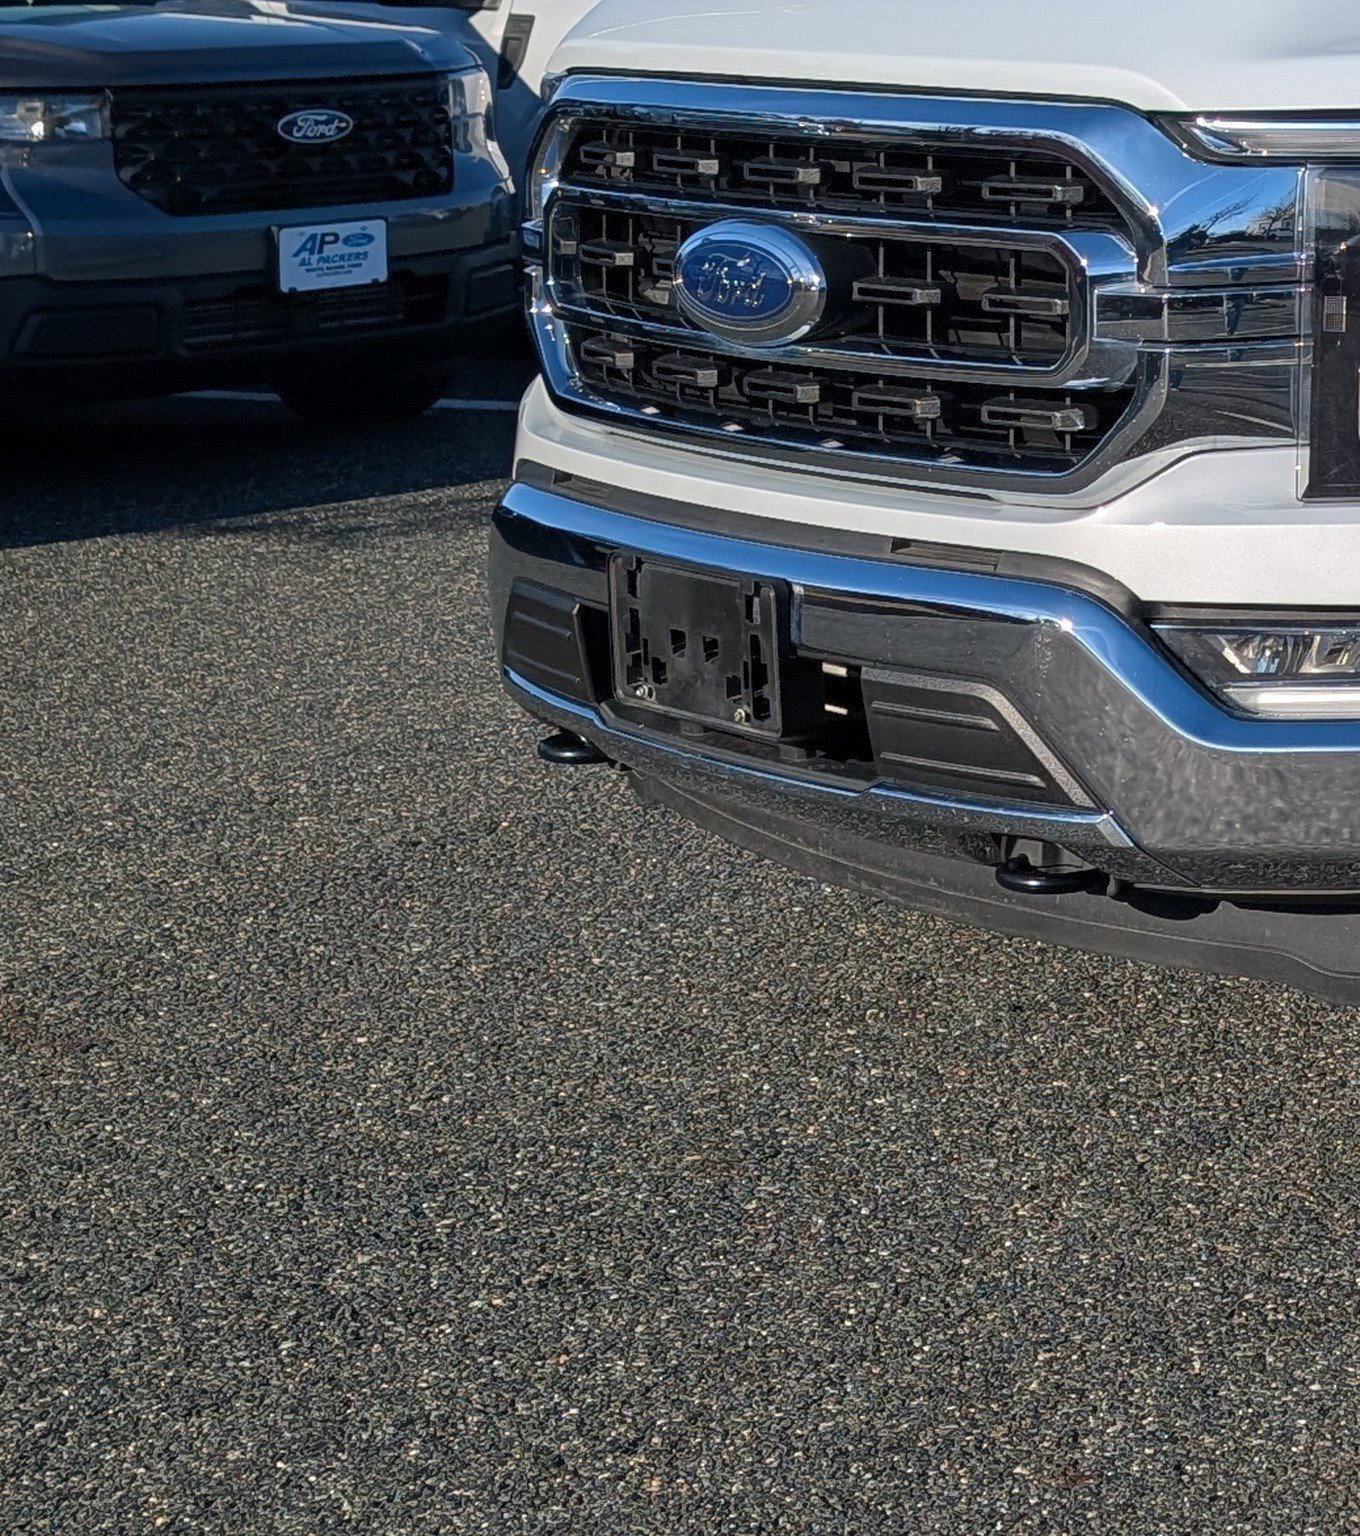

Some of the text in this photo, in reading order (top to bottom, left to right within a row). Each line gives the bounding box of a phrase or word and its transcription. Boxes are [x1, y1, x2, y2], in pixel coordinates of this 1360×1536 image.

[292, 114, 347, 138] Ford
[291, 232, 341, 258] AP
[299, 256, 313, 268] AL
[316, 250, 370, 266] PACKERS
